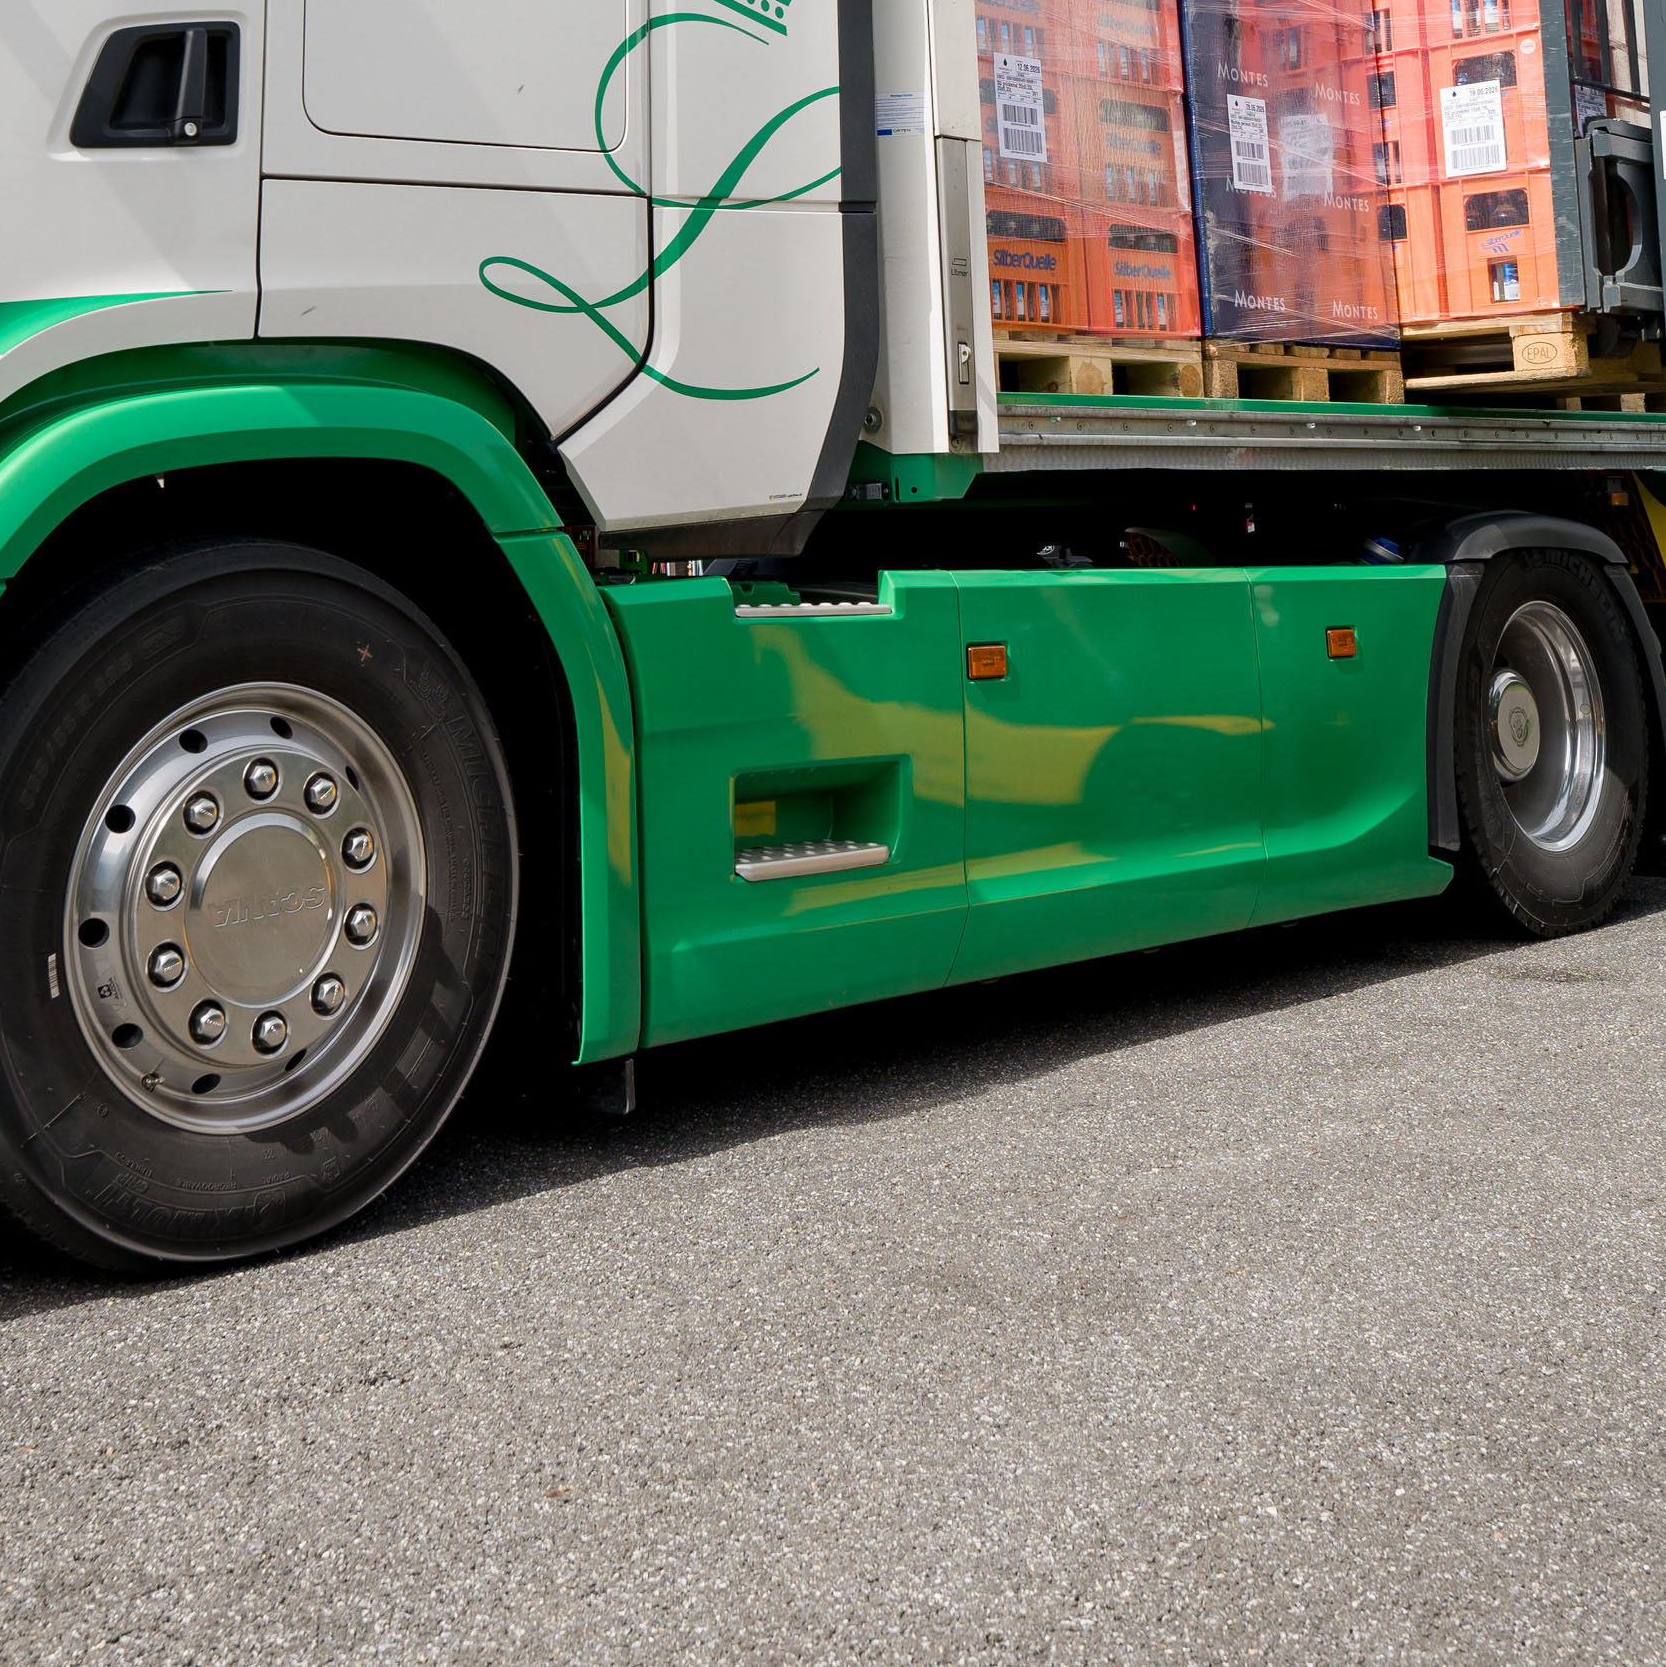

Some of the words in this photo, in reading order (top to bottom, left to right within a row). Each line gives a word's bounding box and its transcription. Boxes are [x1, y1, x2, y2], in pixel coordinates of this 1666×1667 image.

[1217, 62, 1269, 88] MONTES
[1315, 82, 1361, 106] MONTES
[1323, 190, 1370, 214] MONTES
[992, 249, 1058, 272] SilberQuelle
[1114, 261, 1173, 282] SilberQuelle
[1234, 289, 1286, 312] MONTES
[1332, 300, 1378, 320] MONTES
[1527, 344, 1553, 361] EPAL
[213, 883, 326, 929] SCANIA
